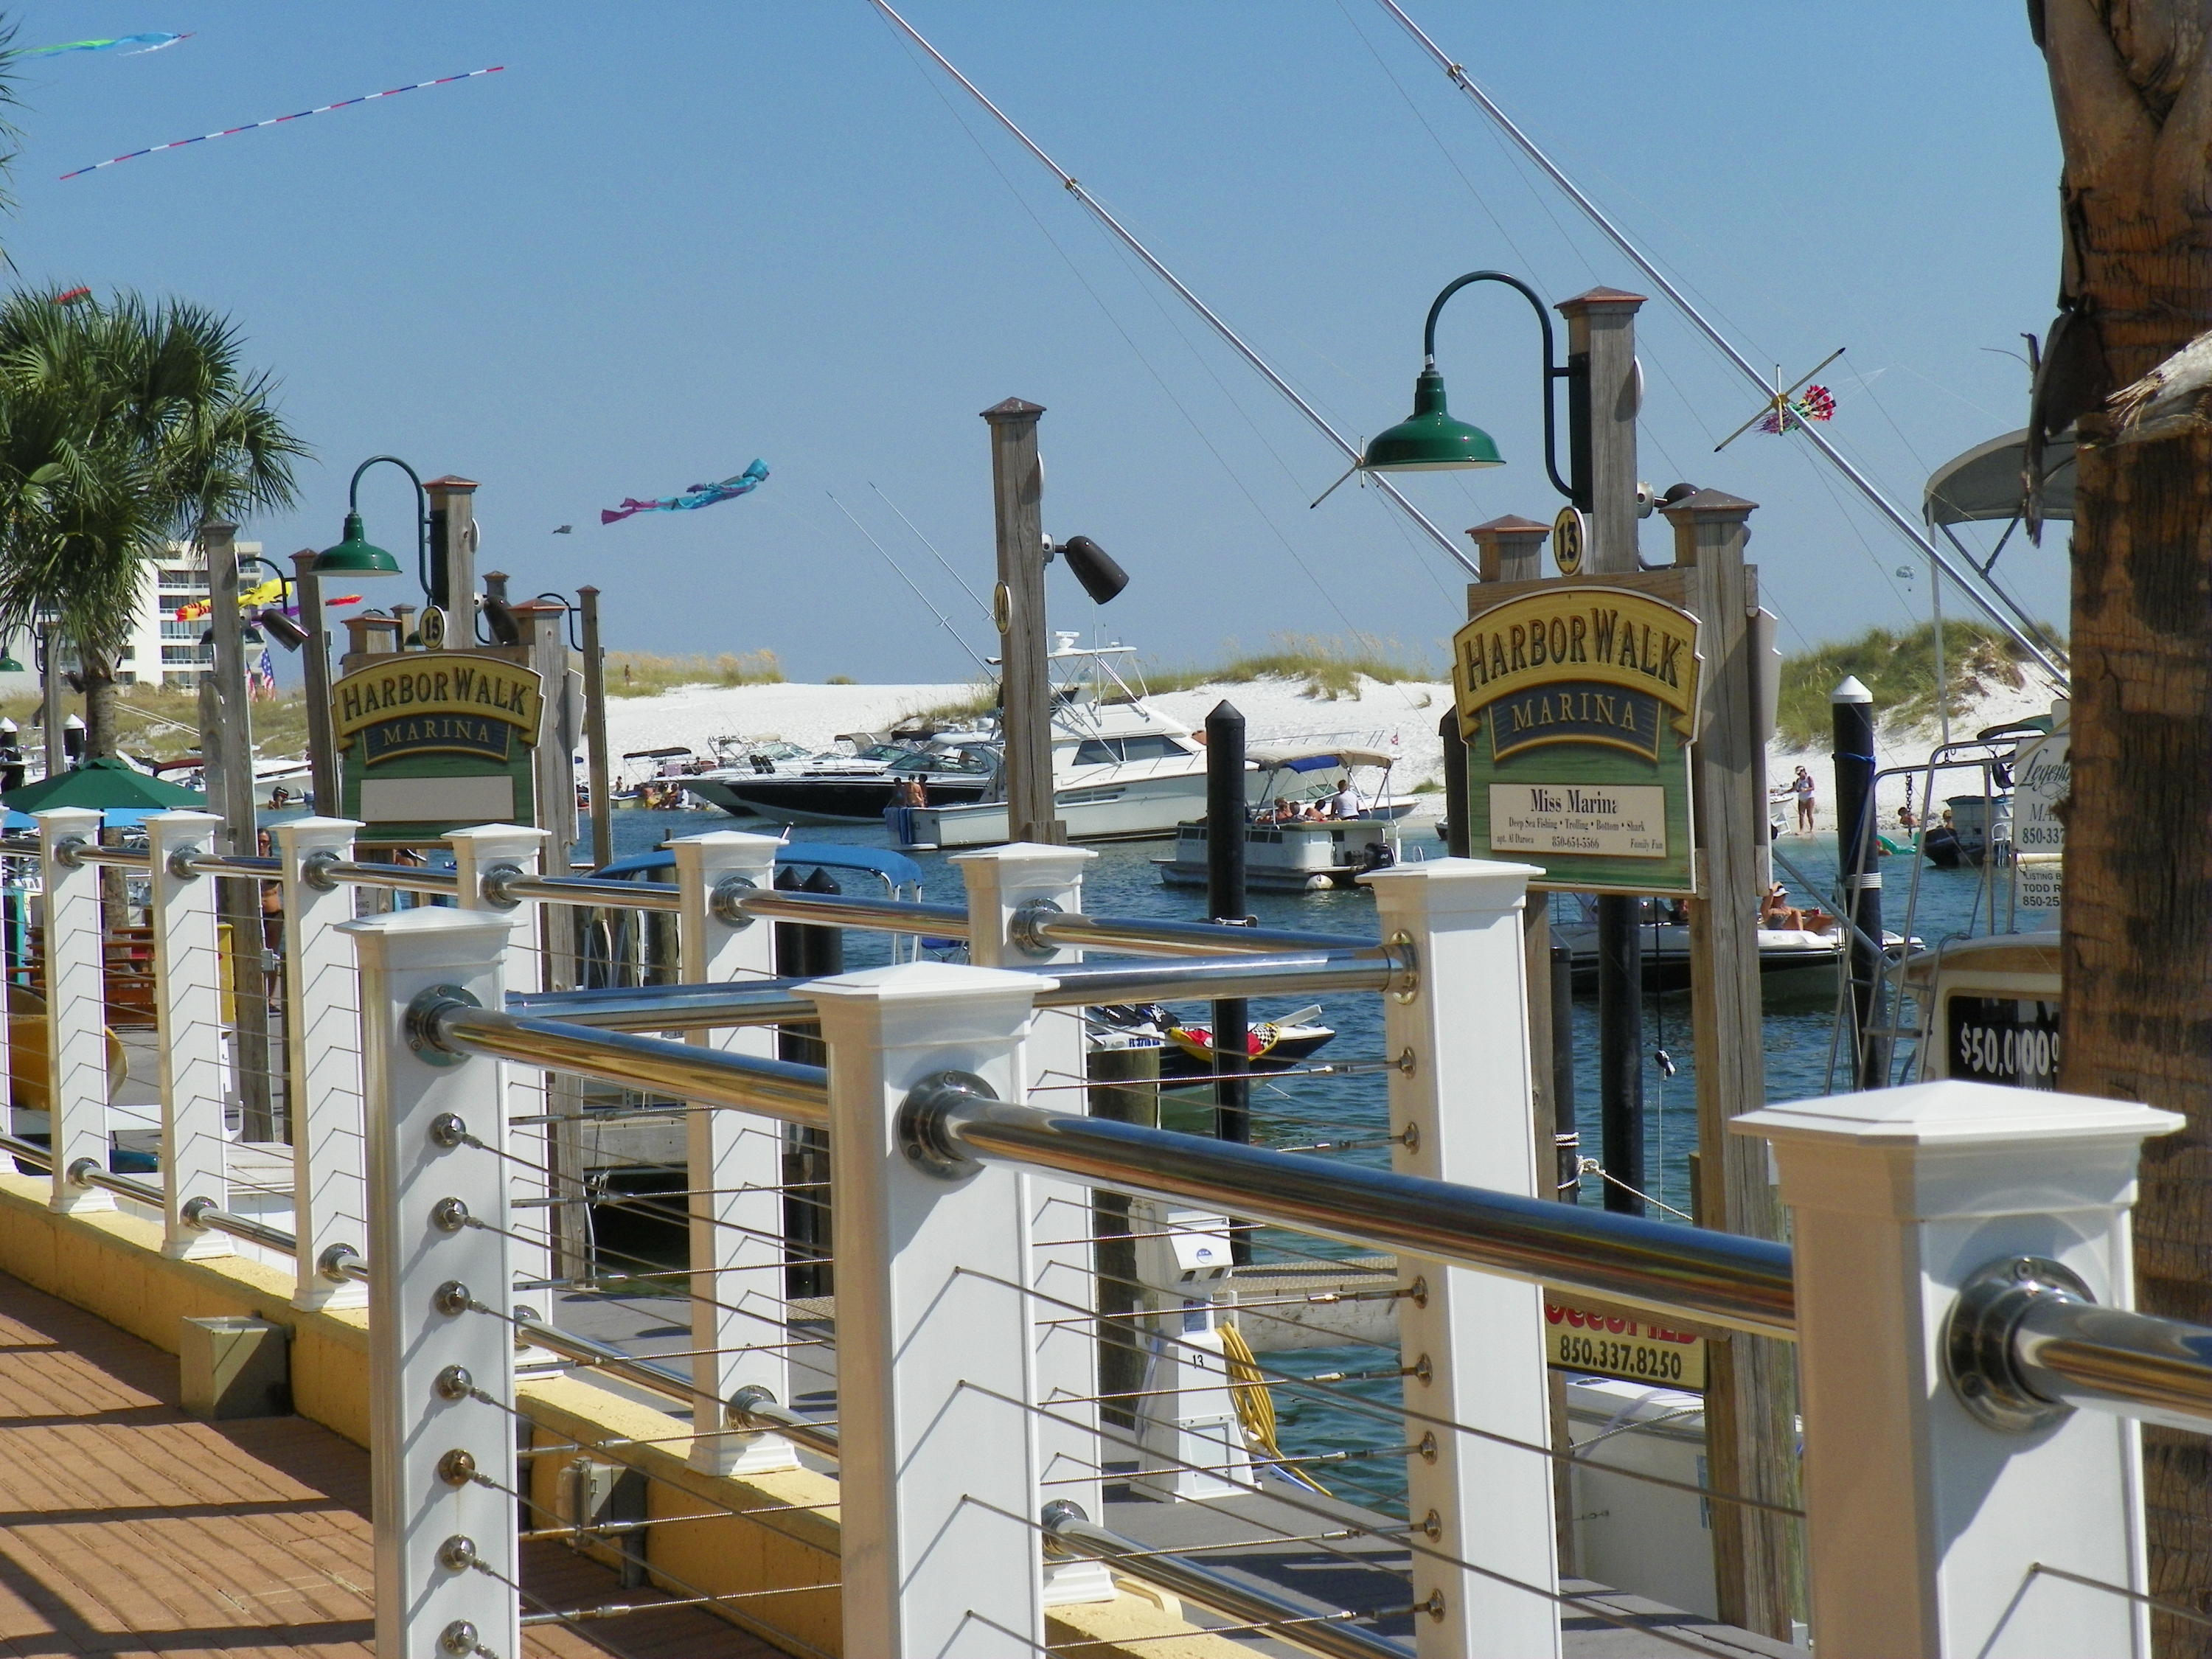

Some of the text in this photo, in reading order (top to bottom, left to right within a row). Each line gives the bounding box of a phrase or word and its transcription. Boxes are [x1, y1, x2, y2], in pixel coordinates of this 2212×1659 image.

[424, 616, 440, 640] 15
[1463, 607, 1683, 692] HARBORWALK
[340, 666, 528, 722] HARBORWALK
[1511, 692, 1637, 733] MARINA
[383, 720, 490, 746] MARINA
[1531, 788, 1562, 813] Miss
[1509, 816, 1646, 832] Deep Sea Fishing Trolling Bottom Shark
[2023, 883, 2050, 892] TODD
[2025, 872, 2053, 880] LISTING
[1192, 1354, 1204, 1368] 13
[1559, 1334, 1682, 1381] 850.337.8250
